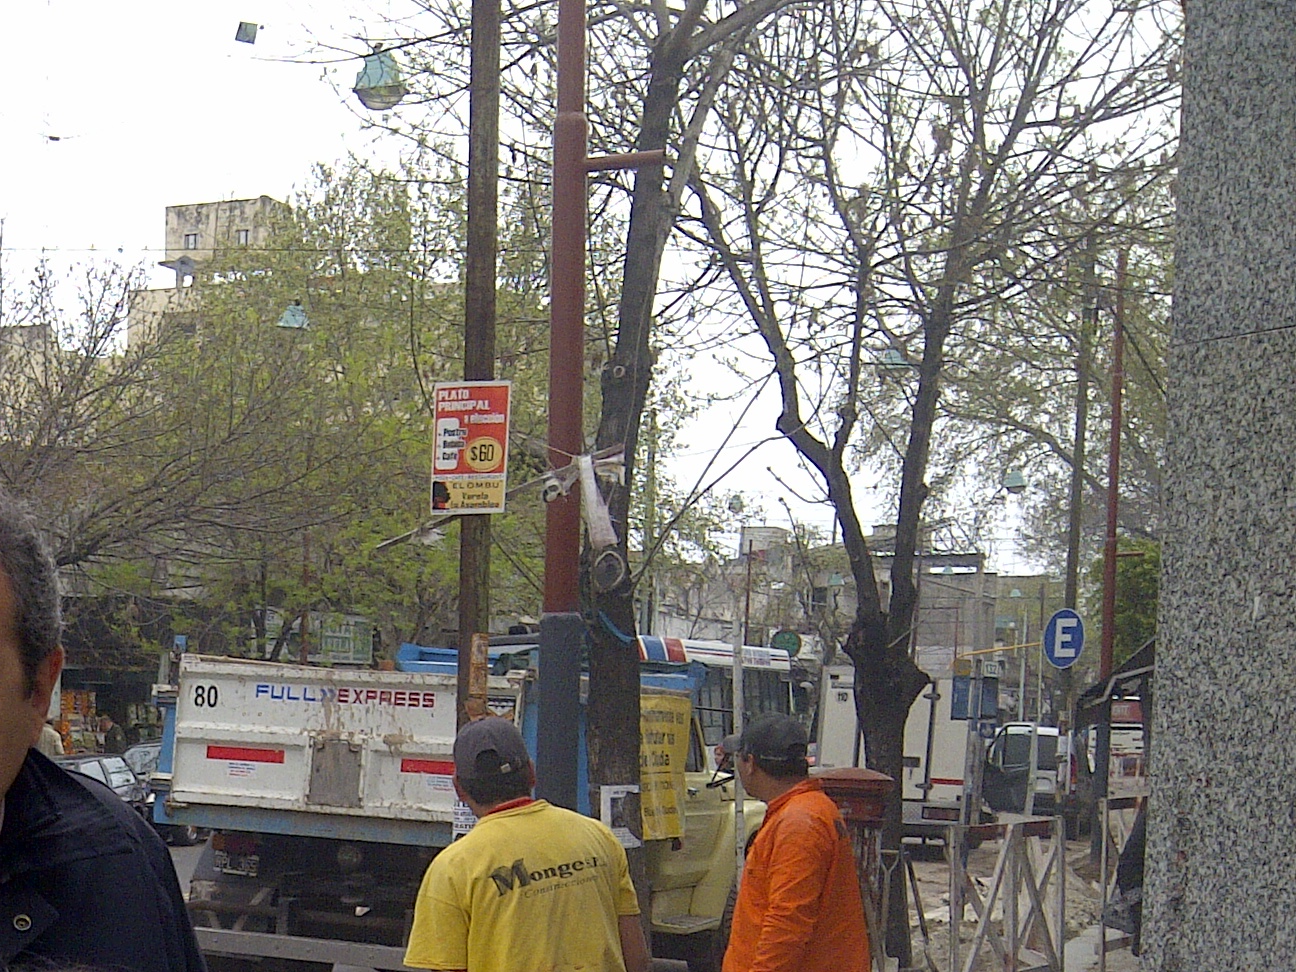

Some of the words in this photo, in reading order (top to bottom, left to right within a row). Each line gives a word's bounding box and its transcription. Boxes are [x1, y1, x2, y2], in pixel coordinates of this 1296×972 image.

[438, 388, 469, 401] PLATO
[438, 400, 490, 412] PRINCIPAL
[1054, 618, 1078, 658] E
[194, 685, 218, 708] 80
[255, 684, 317, 702] FULL
[337, 689, 436, 708] EXPRESS
